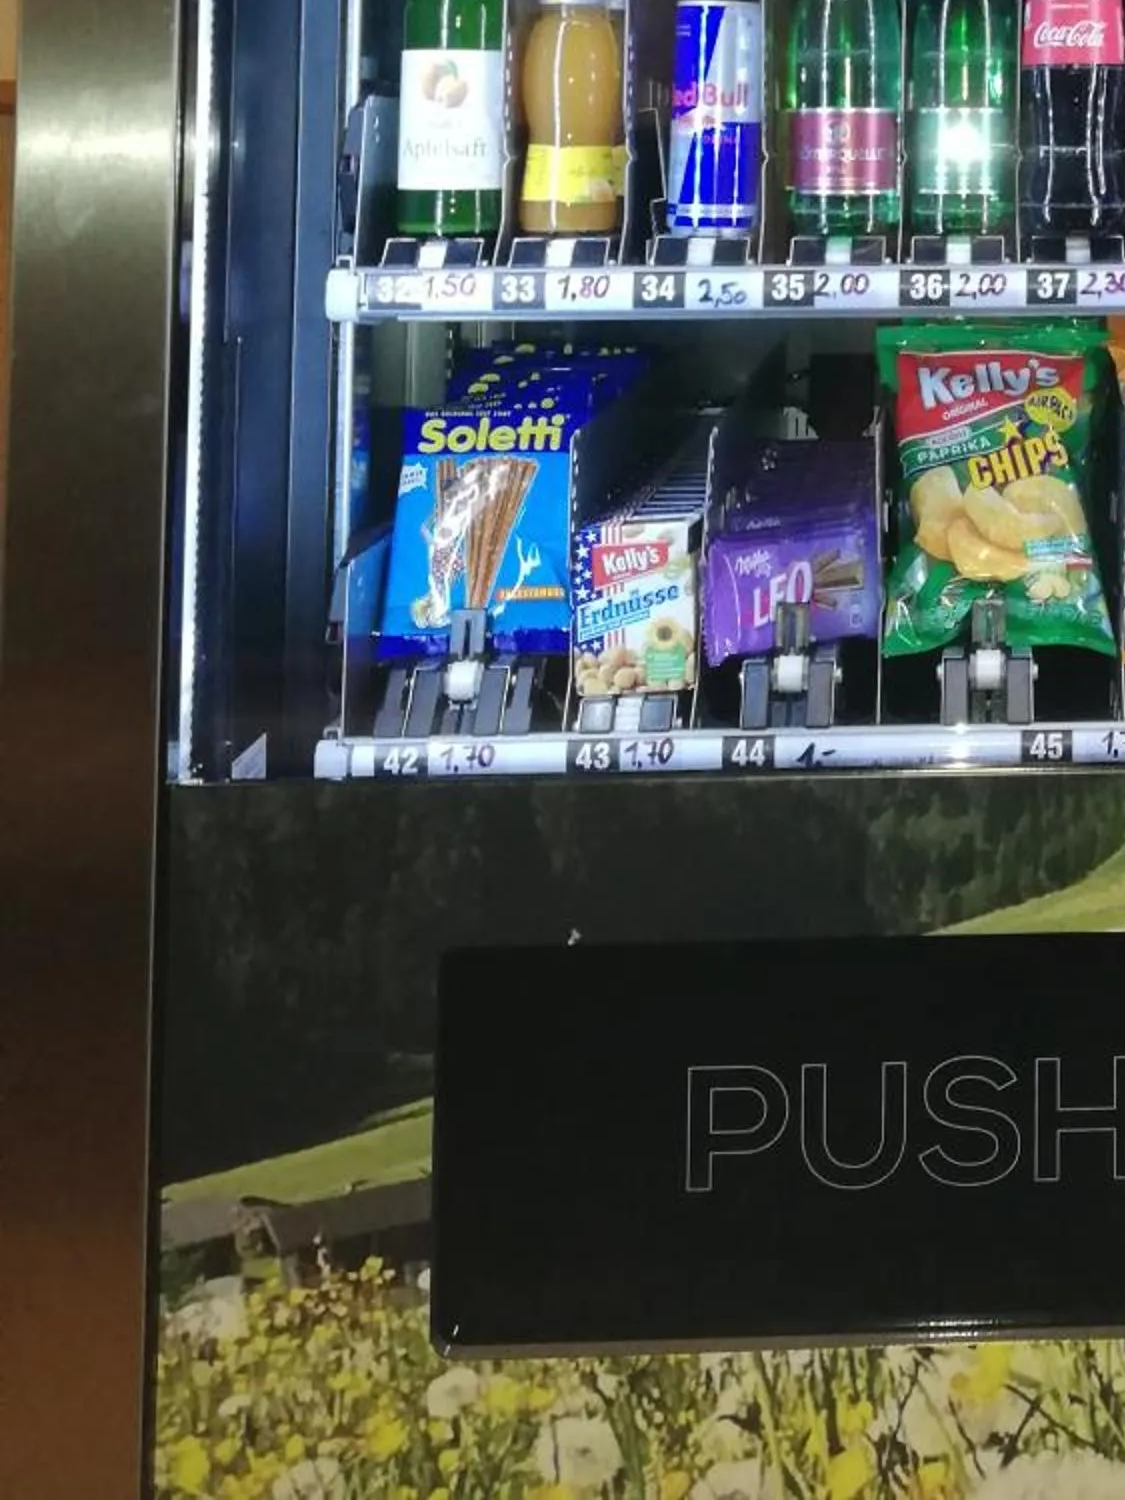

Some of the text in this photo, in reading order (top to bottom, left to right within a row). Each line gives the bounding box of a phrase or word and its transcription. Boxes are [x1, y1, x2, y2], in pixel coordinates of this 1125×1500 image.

[671, 80, 749, 108] ed Bull
[402, 136, 487, 162] Apfelsaft
[501, 276, 536, 302] 33
[641, 276, 677, 301] 34
[771, 274, 805, 300] 35
[909, 273, 943, 299] 36
[1037, 272, 1070, 299] 37
[916, 358, 1058, 410] Kelly's
[418, 414, 566, 453] Soletti
[916, 436, 991, 463] PAPRIKA
[968, 428, 1069, 490] CHIPS
[602, 546, 661, 578] Kelly's
[580, 584, 680, 629] Erdnüsse
[575, 741, 611, 770] 43
[731, 739, 765, 767] 44
[1029, 732, 1065, 760] 45
[383, 746, 419, 775] 42
